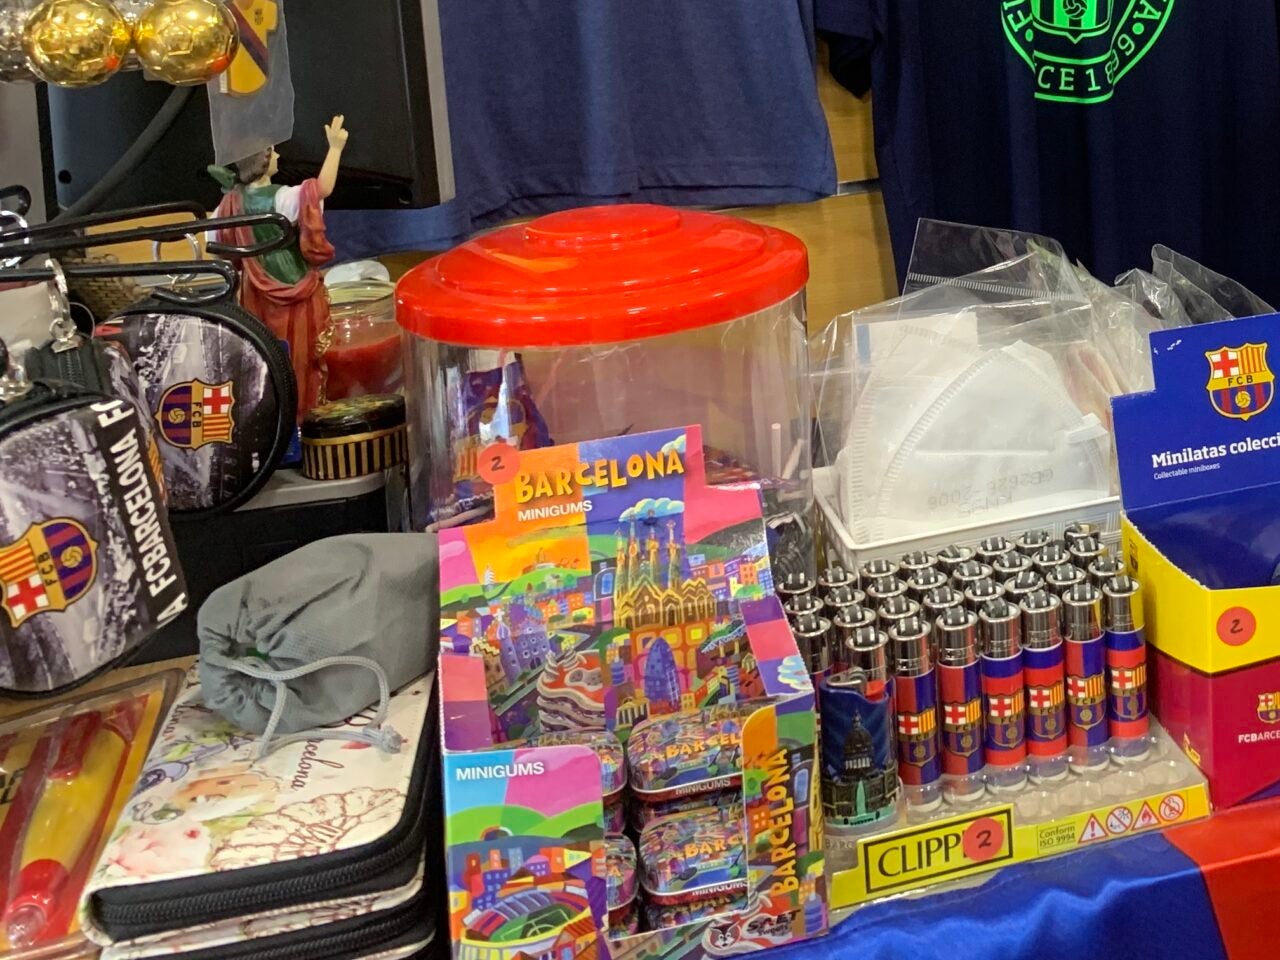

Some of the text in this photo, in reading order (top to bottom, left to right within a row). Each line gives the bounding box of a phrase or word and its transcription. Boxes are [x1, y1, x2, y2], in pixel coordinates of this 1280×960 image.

[1227, 374, 1254, 387] FCB
[491, 455, 506, 472] 2
[1151, 443, 1227, 469] Minilatas
[514, 448, 686, 505] BARCELONA
[1153, 467, 1188, 480] Collectable
[109, 428, 178, 597] FCBARCELONA
[517, 500, 593, 522] MINIGUMS
[37, 550, 59, 587] FCB
[1229, 618, 1244, 635] 2
[664, 732, 743, 759] BARCEL
[455, 761, 545, 782] MINIGUMS
[768, 748, 800, 898] BARCELONA
[1039, 823, 1077, 840] Conform
[975, 830, 992, 849] 2
[1039, 837, 1055, 848] ISO
[878, 829, 967, 878] CLIPP
